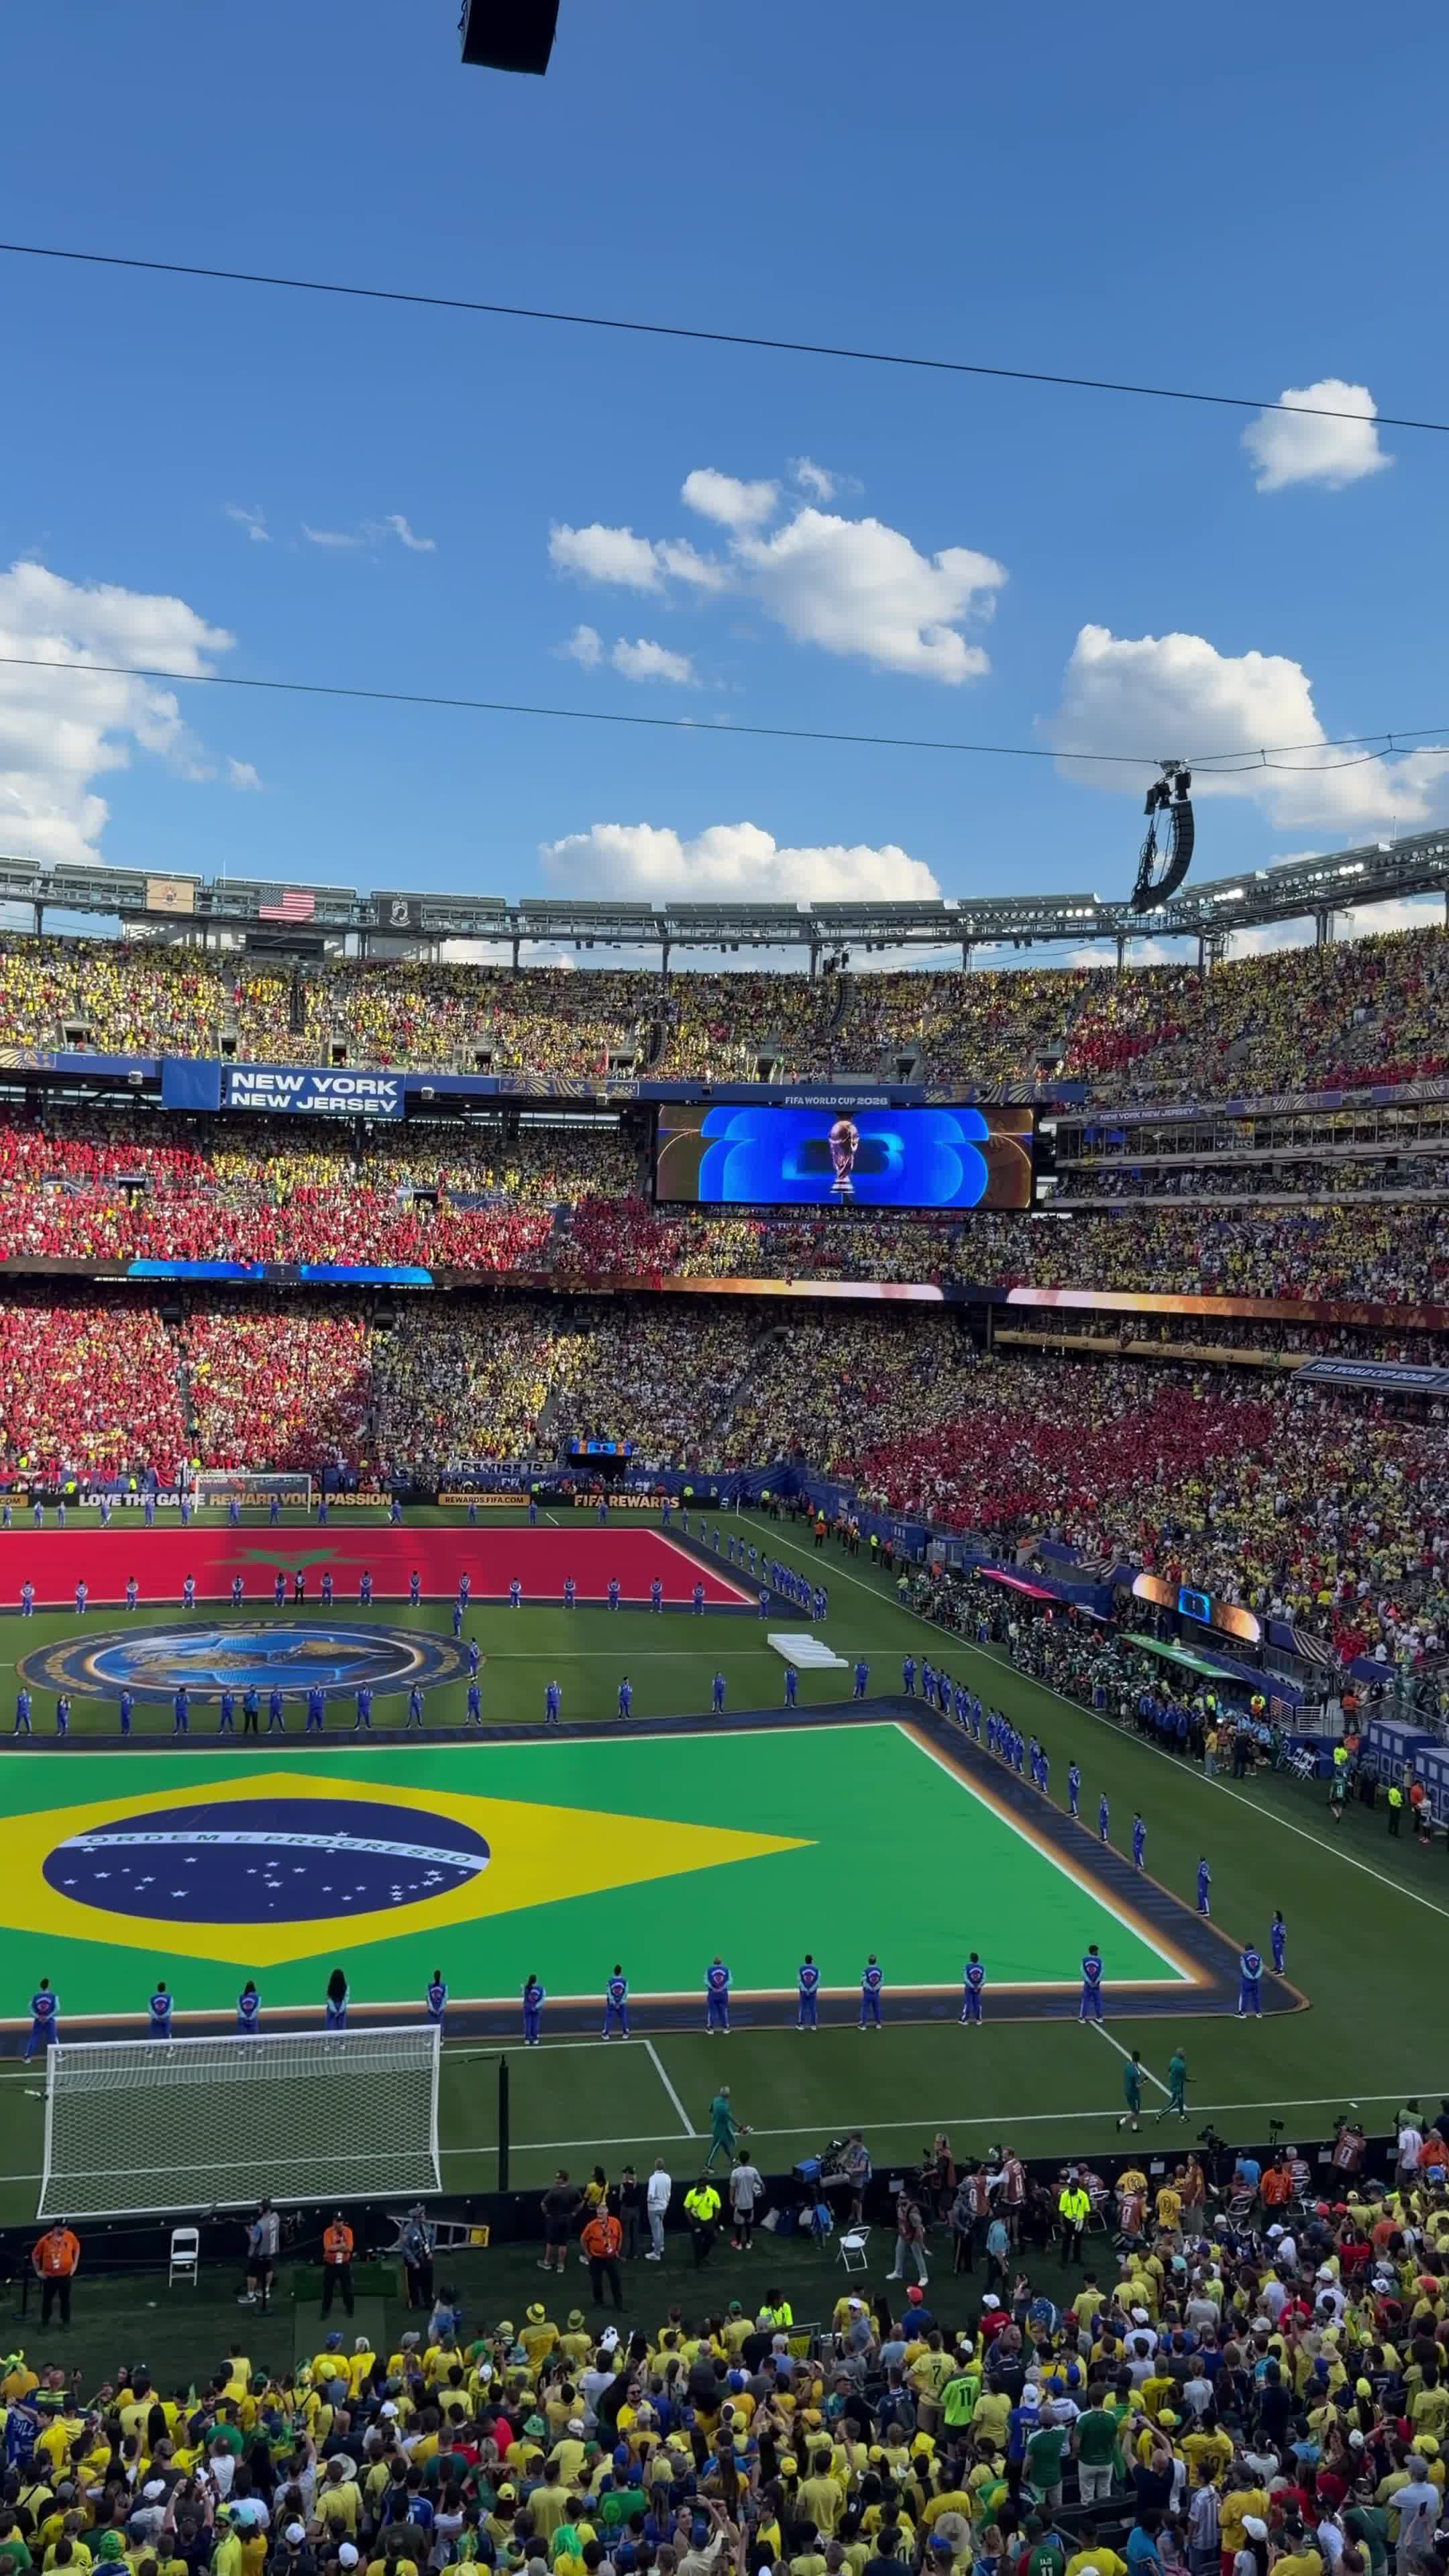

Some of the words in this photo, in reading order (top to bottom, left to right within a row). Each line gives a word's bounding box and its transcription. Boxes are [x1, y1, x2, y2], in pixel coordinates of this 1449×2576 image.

[231, 1073, 305, 1091] NEW
[311, 1077, 398, 1095] YORK
[231, 1092, 291, 1108] NEW
[296, 1096, 398, 1112] JERSEY
[785, 1096, 804, 1105] FIFA
[804, 1096, 837, 1105] WORLD
[838, 1097, 856, 1106] CUP
[857, 1097, 888, 1106] 2026
[1099, 1114, 1118, 1122] NEW
[1118, 1112, 1140, 1120] YORK
[1161, 1107, 1194, 1117] JERSEY
[1310, 1363, 1336, 1373] FIFA
[1333, 1365, 1373, 1376] WORLD
[1371, 1369, 1397, 1378] CUP
[1391, 1371, 1436, 1382] 2026
[78, 1493, 125, 1507] LOVE
[125, 1493, 156, 1507] THE
[156, 1493, 205, 1506] GAME
[210, 1492, 278, 1506] REWARD
[280, 1492, 322, 1506] YOUR
[325, 1492, 392, 1506] PASSION
[445, 1496, 524, 1504] REWARDS.FIFA.COM
[574, 1495, 605, 1507] FIFA
[608, 1495, 680, 1509] REWARDS
[87, 1833, 221, 1843] ORDEM
[263, 1835, 472, 1864] PROGRESSO
[932, 2365, 942, 2385] 7
[959, 2386, 971, 2407] 11
